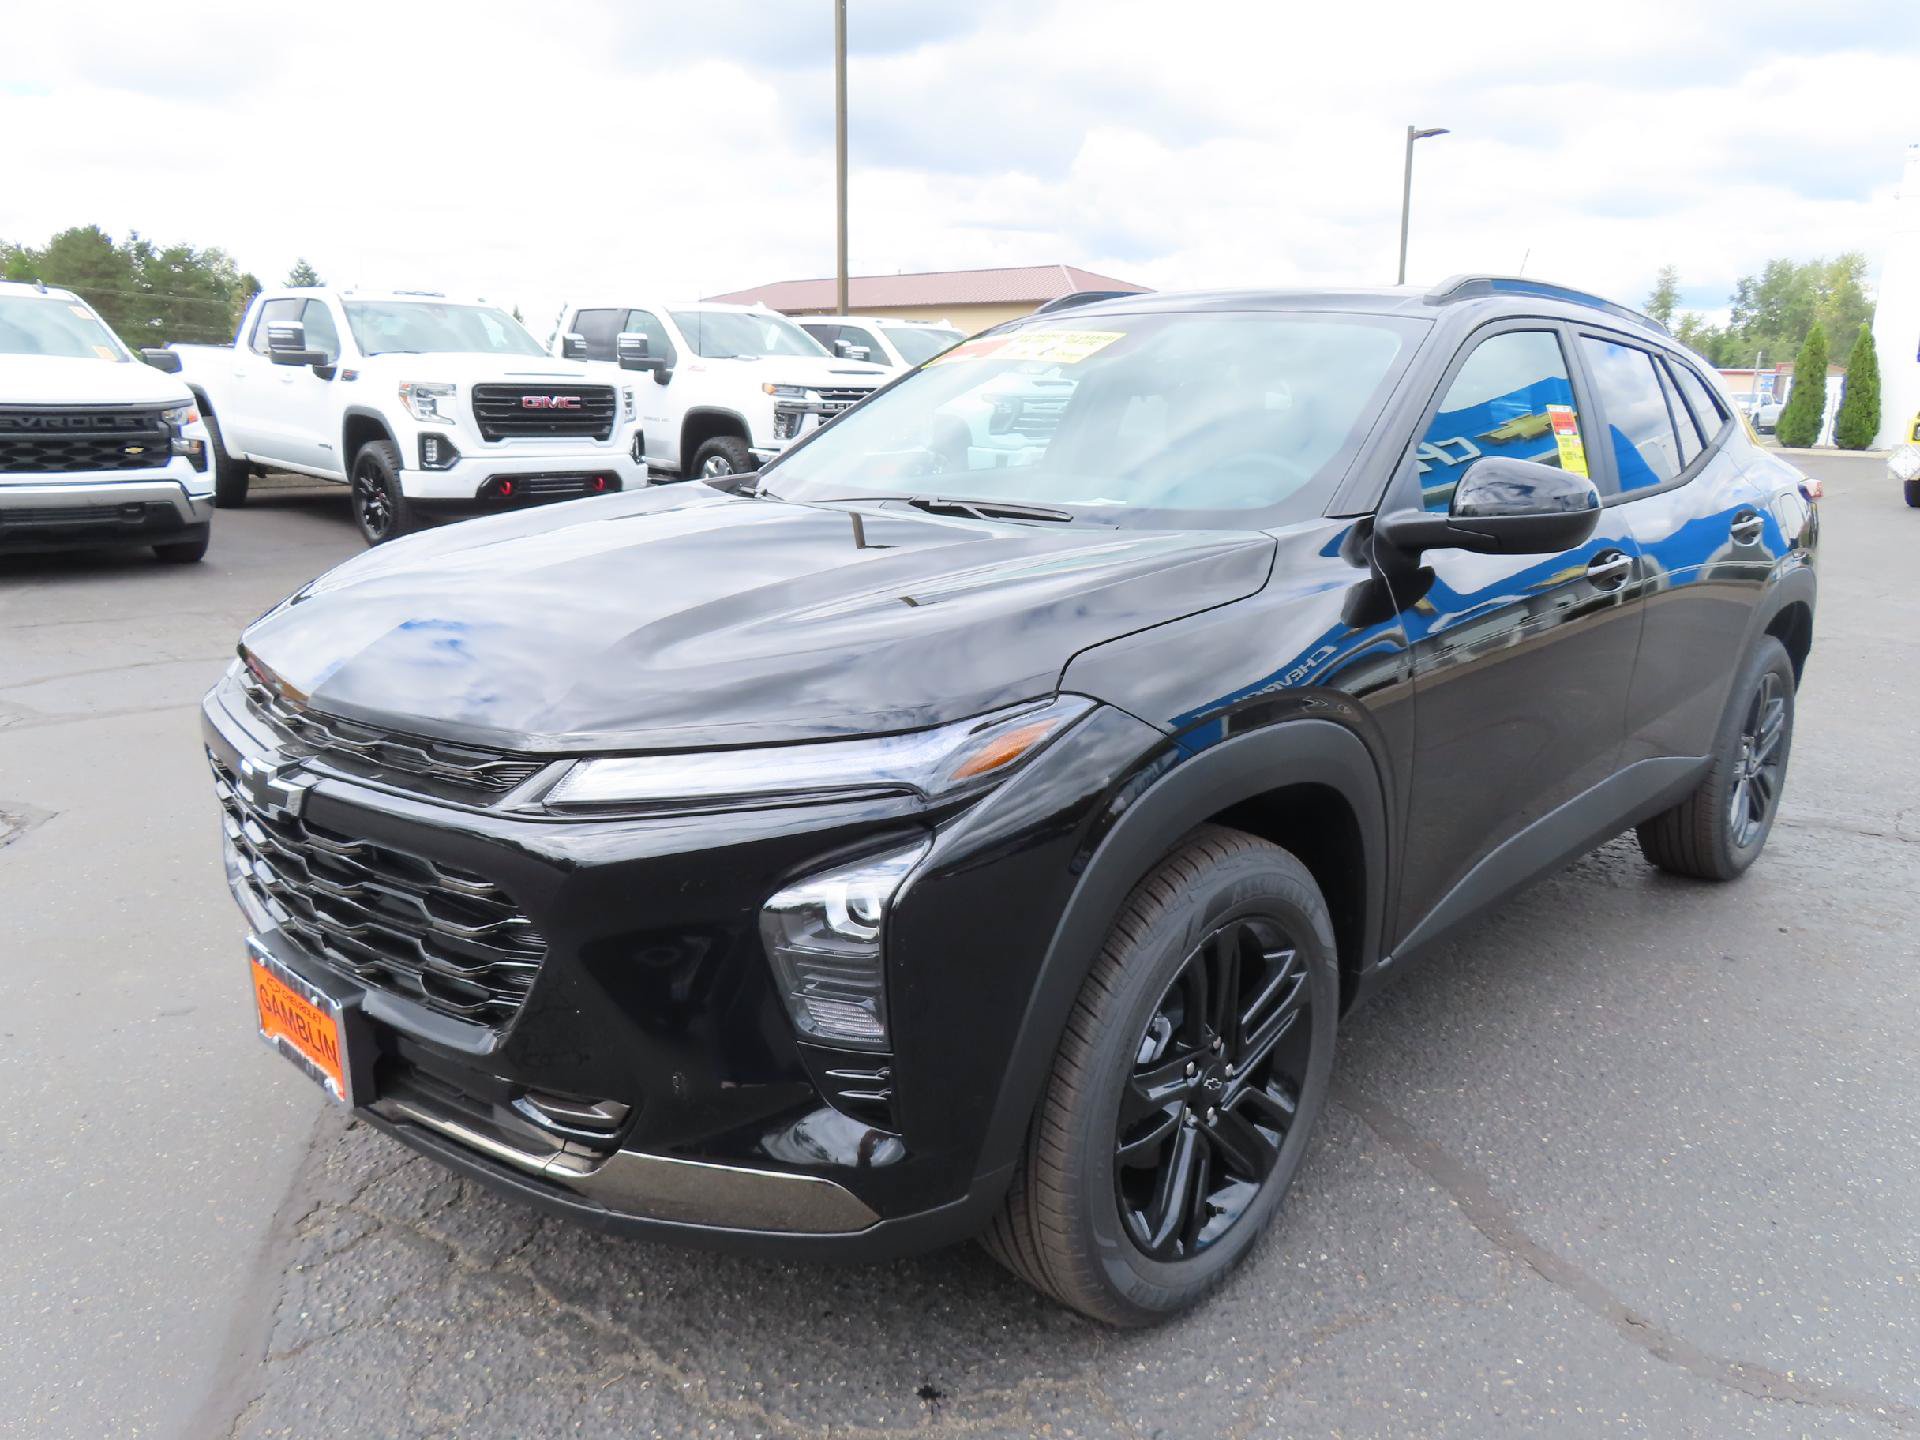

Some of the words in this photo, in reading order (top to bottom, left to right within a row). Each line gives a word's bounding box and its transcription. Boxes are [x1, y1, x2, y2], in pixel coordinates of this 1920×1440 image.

[522, 395, 581, 408] GMC
[0, 415, 157, 429] EVROLET
[260, 983, 339, 1067] GAMBLIN
